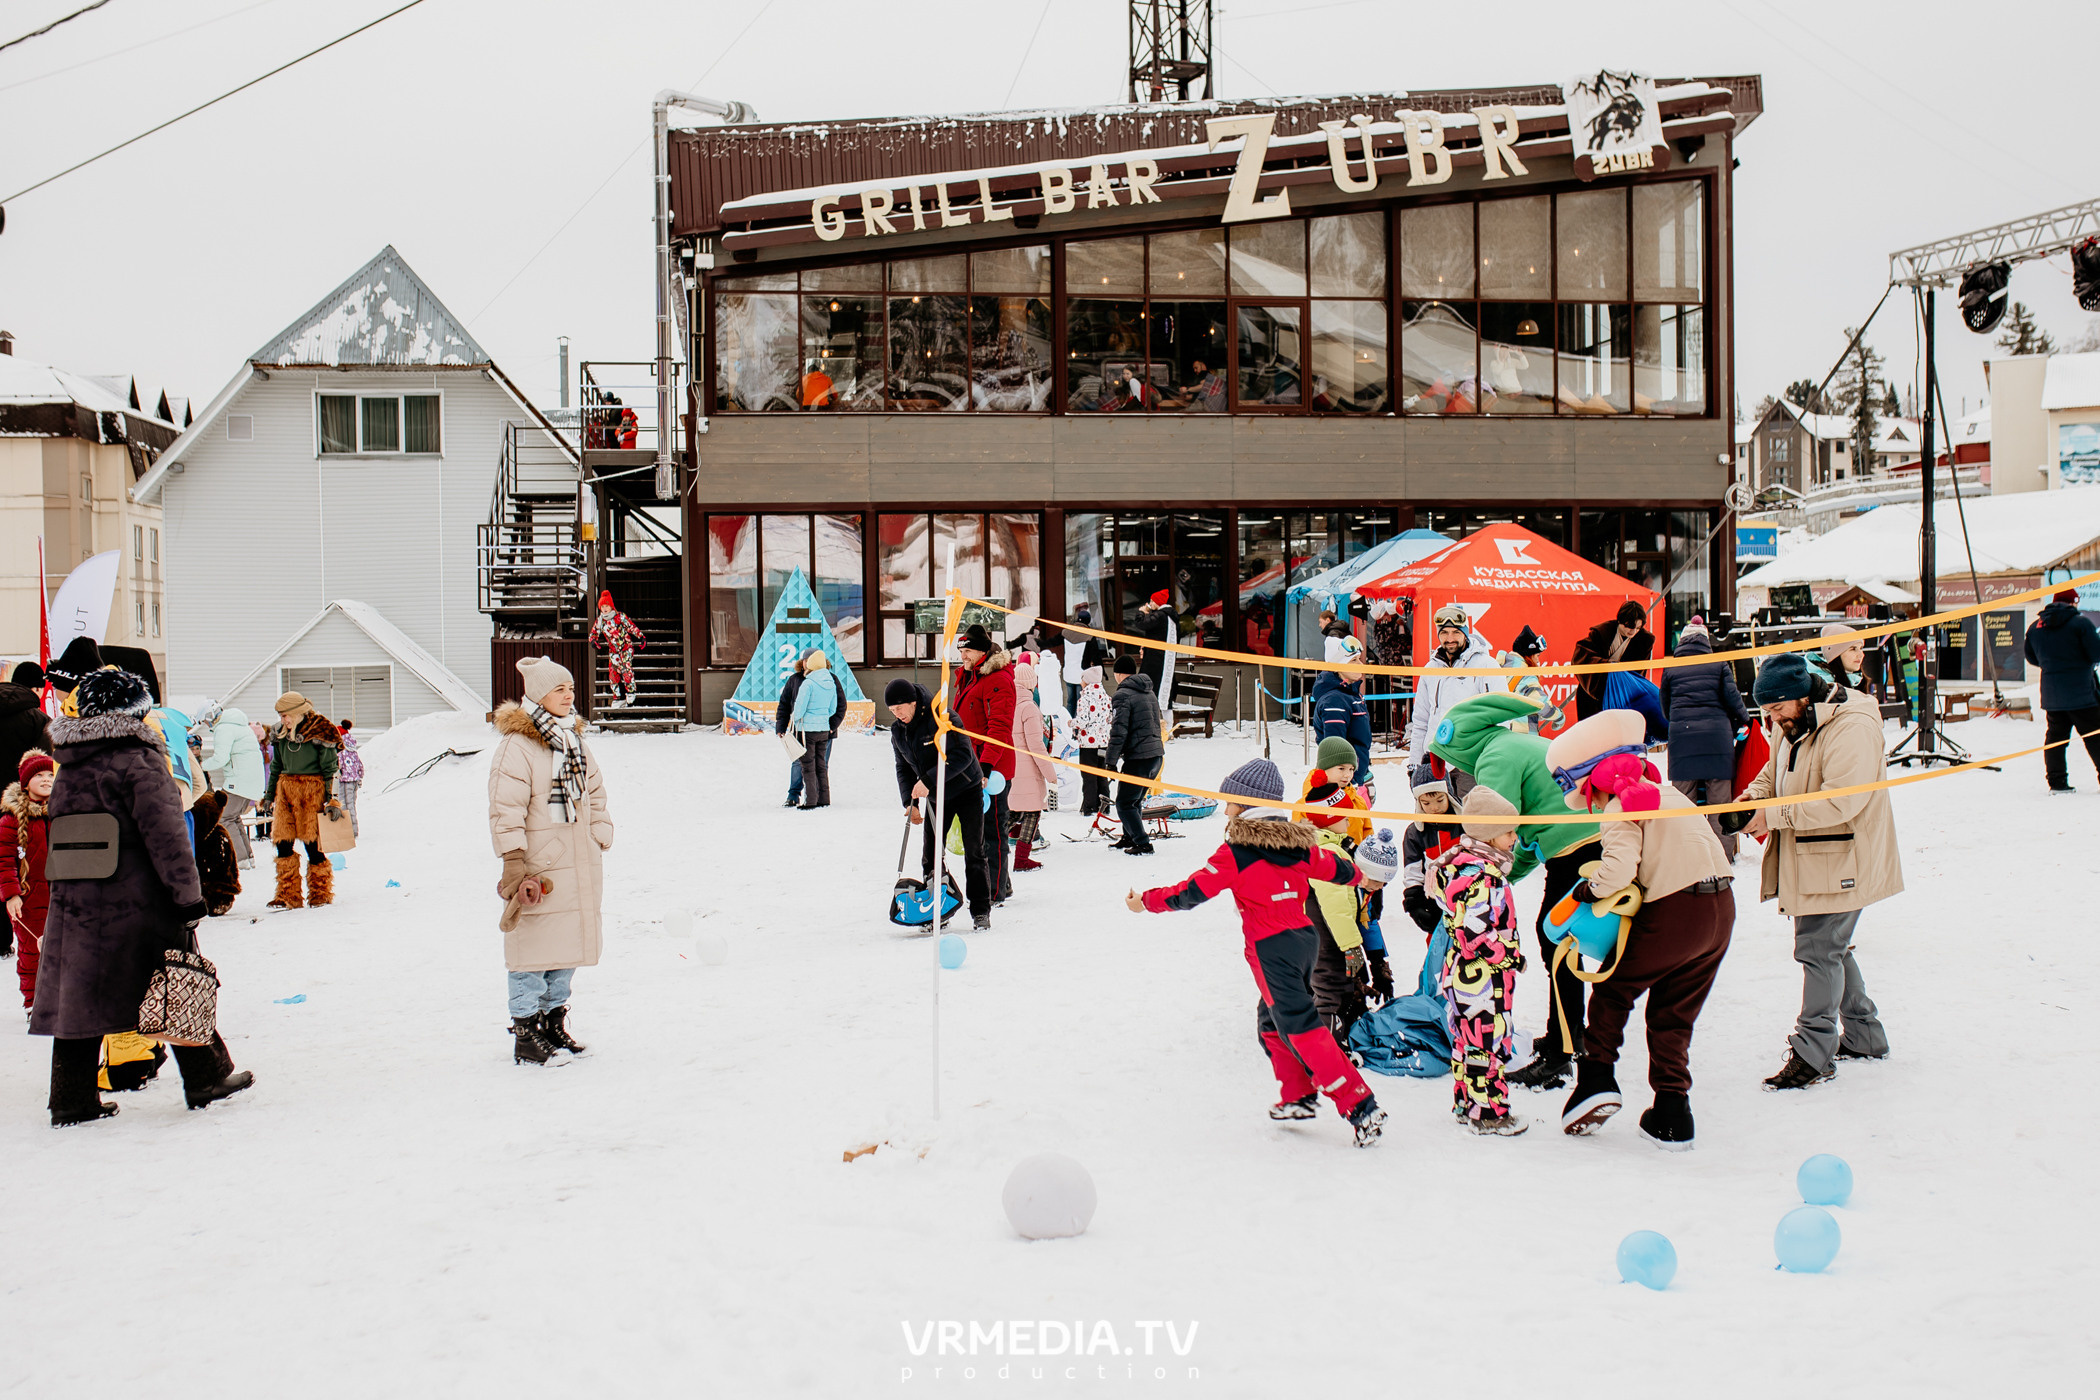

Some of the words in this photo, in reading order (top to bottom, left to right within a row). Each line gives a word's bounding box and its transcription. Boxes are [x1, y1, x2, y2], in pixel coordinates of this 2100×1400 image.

[1591, 149, 1657, 175] ZUBR
[811, 178, 1013, 242] GRILL
[1039, 159, 1162, 215] BAR
[1473, 566, 1584, 581] КУЗБАССКАЯ
[1468, 577, 1532, 590] МЕДИА
[1534, 581, 1600, 592] ГРУППА
